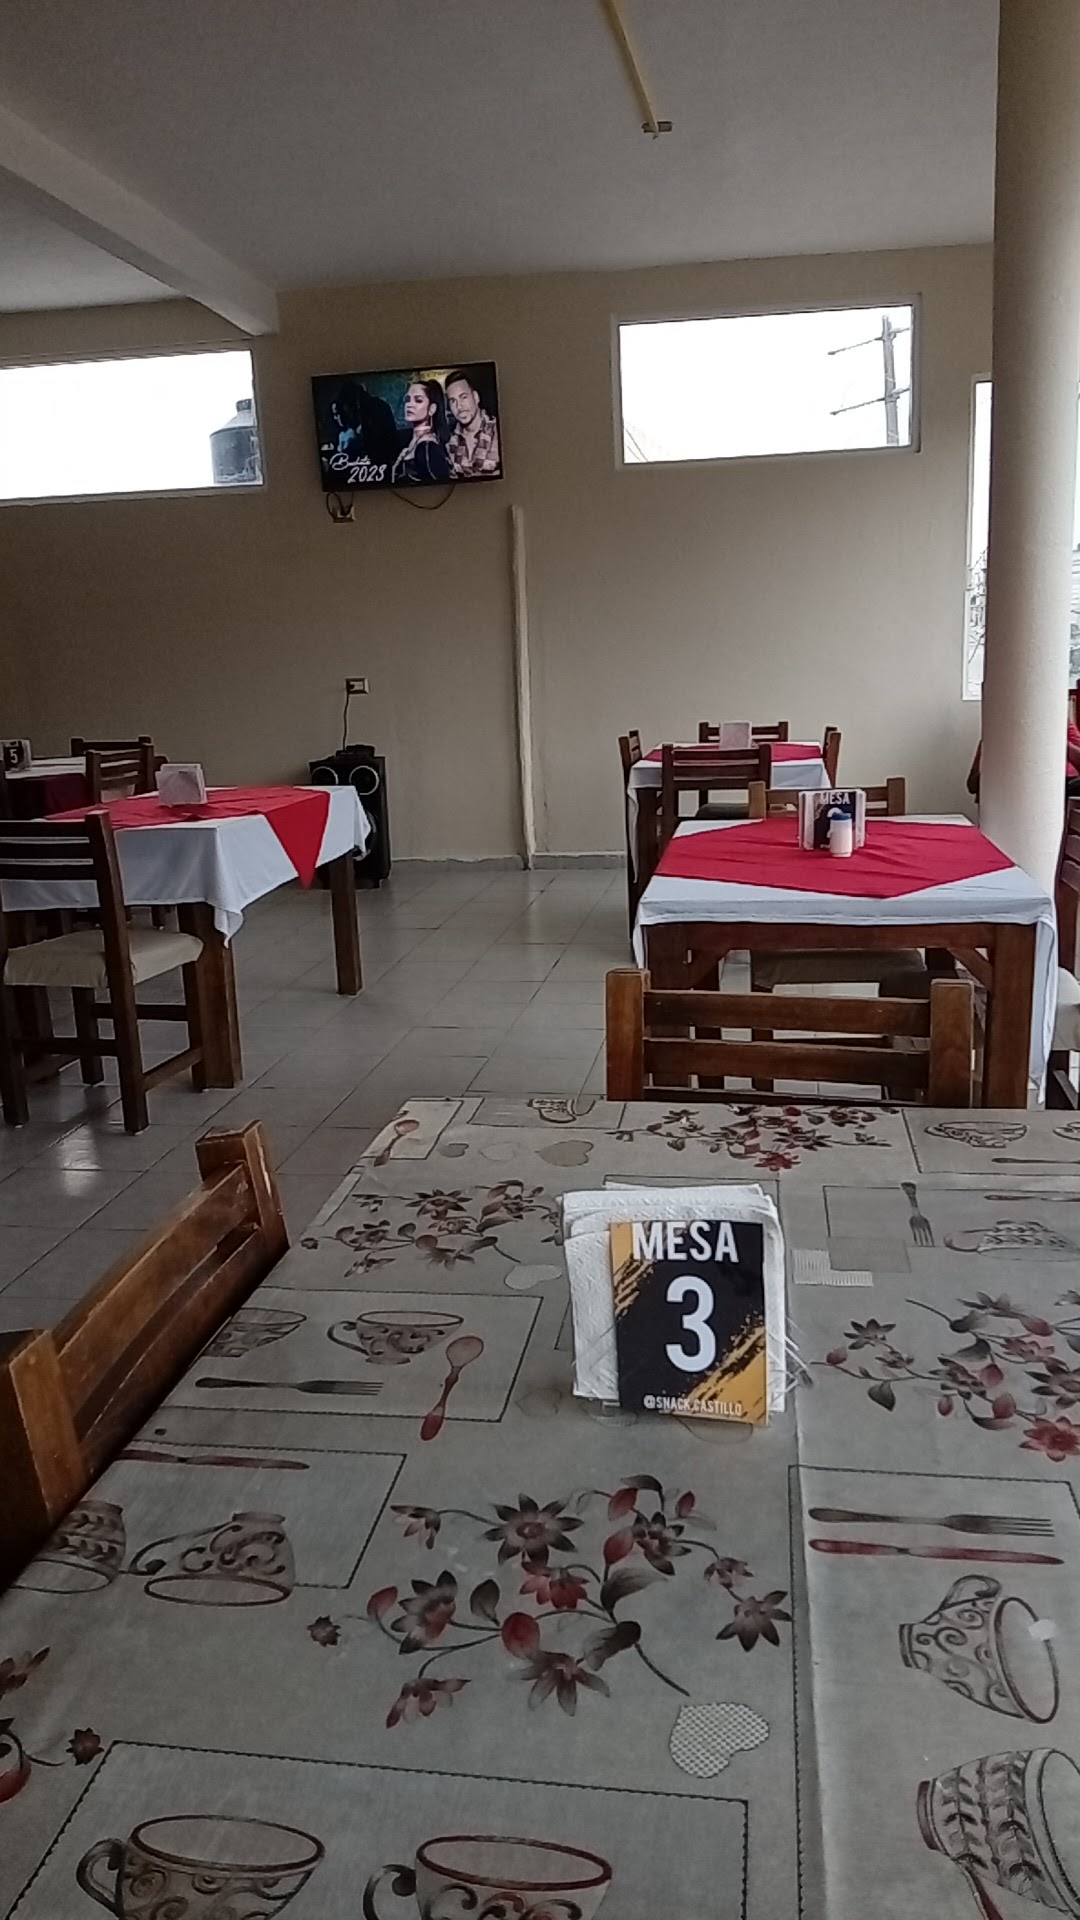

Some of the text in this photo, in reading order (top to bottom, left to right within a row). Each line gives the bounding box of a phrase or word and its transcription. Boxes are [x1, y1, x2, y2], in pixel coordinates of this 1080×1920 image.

[347, 464, 387, 483] 2023
[10, 749, 18, 763] 5
[820, 791, 850, 804] MESA
[631, 1220, 739, 1263] MESA
[665, 1274, 717, 1373] 3
